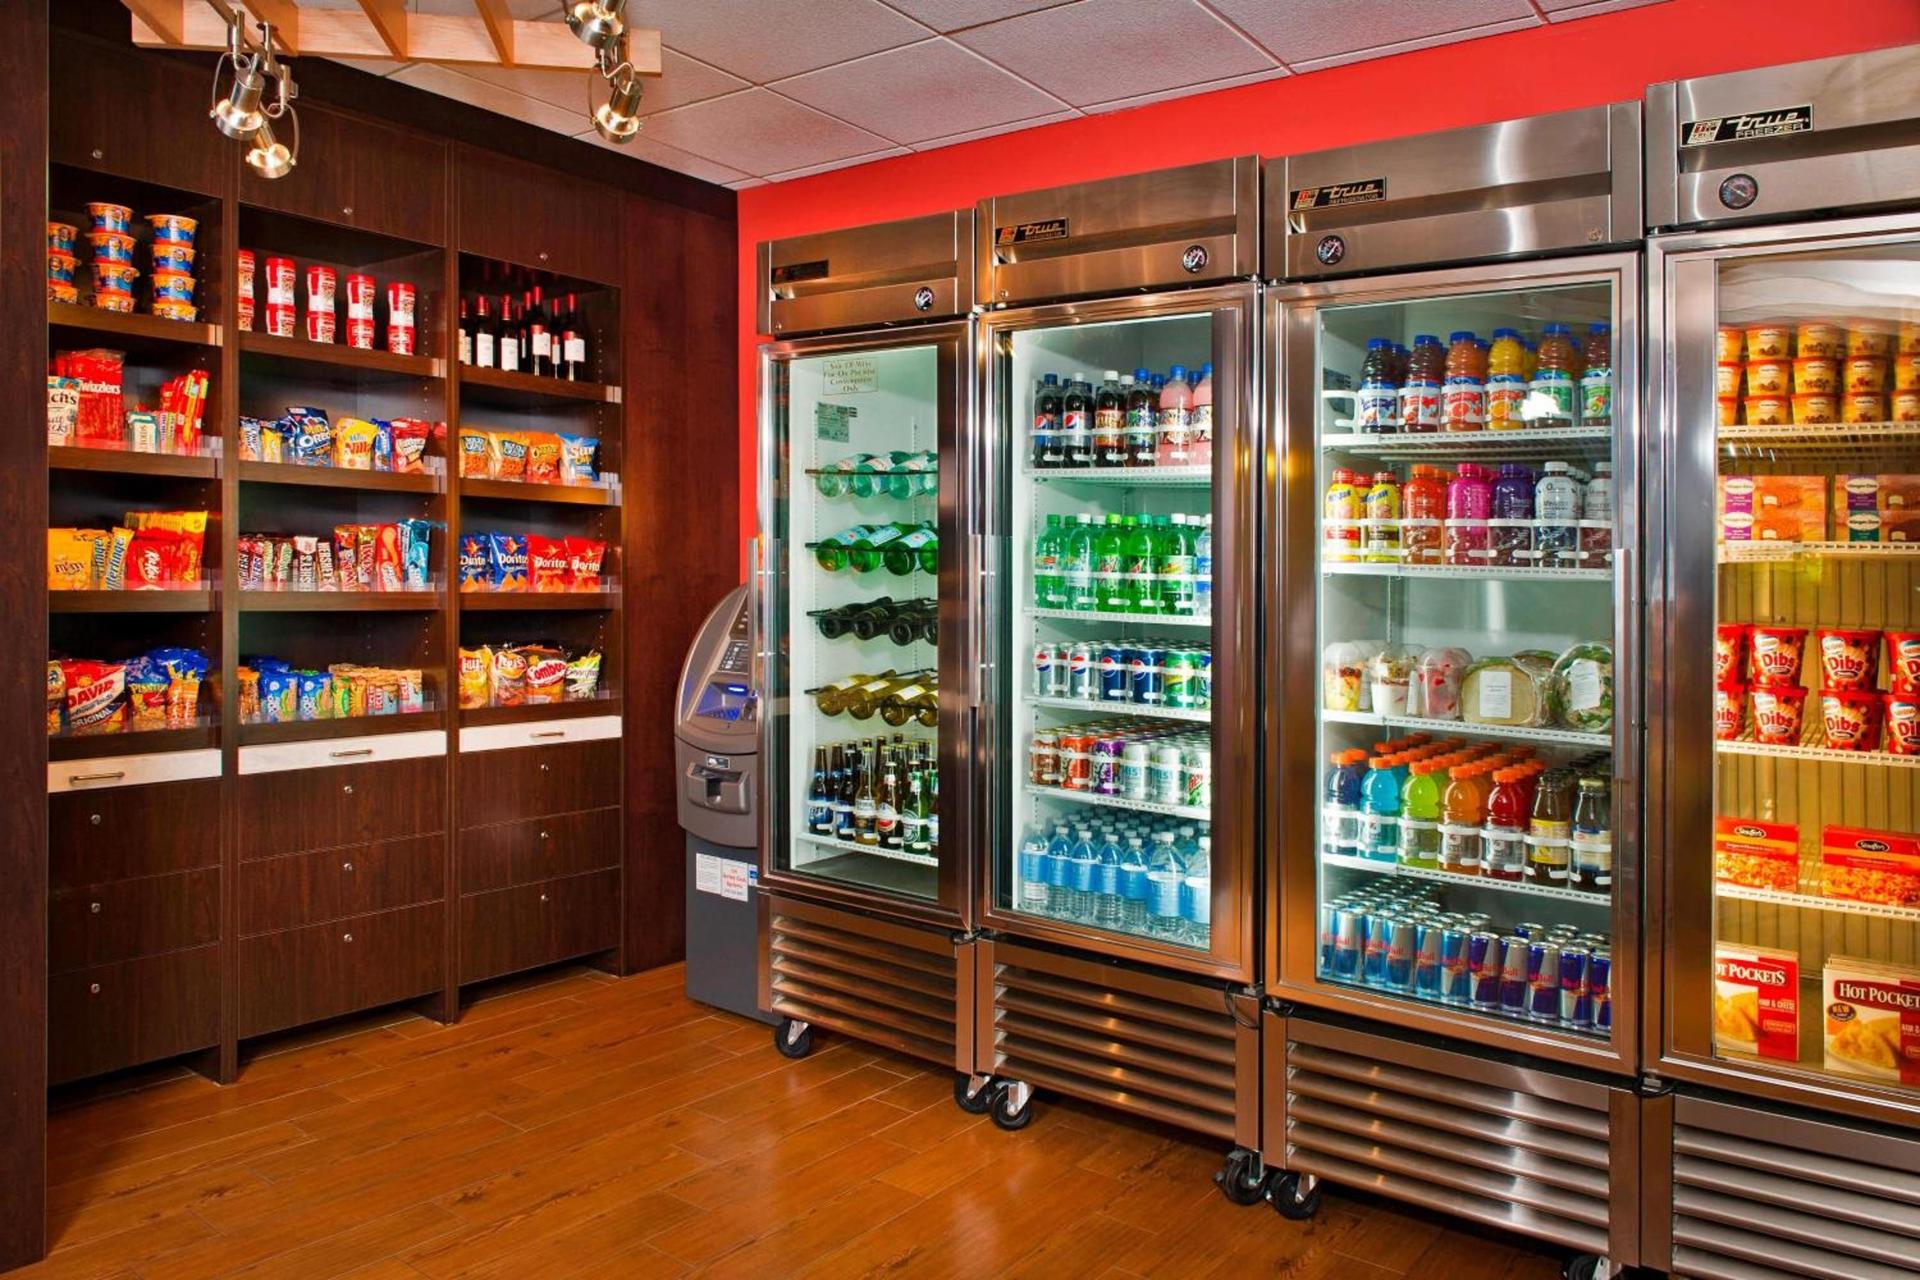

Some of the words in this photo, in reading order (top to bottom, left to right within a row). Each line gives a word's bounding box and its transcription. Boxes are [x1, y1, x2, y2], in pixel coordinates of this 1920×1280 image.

[1735, 123, 1804, 139] FREEZER
[1762, 652, 1795, 669] Dibs
[1828, 656, 1864, 671] Dibs
[1760, 711, 1794, 727] Dibs
[1826, 716, 1861, 731] Dibs
[1729, 963, 1786, 985] POCKETS
[1839, 982, 1867, 1000] HOT
[1869, 987, 1920, 1008] POCKET
